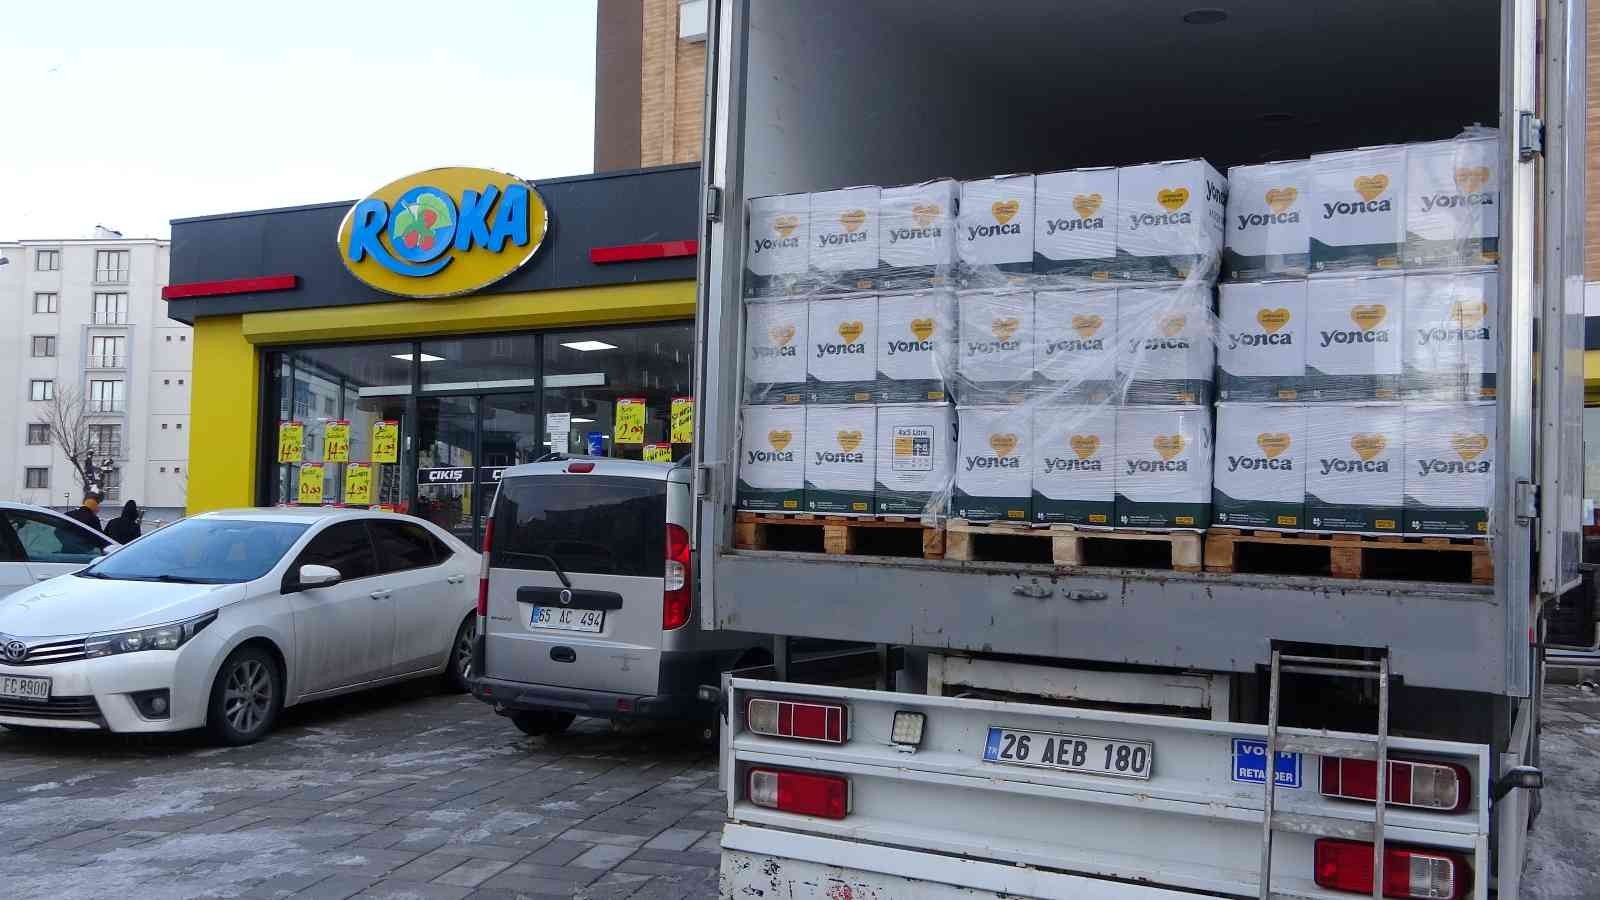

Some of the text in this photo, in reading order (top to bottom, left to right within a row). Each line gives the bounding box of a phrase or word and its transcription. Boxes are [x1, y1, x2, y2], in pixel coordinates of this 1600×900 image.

[1323, 199, 1391, 219] yonca
[1421, 193, 1494, 213] yonca
[1047, 216, 1104, 235] yonca
[1129, 211, 1191, 231] yonca
[1237, 211, 1300, 230] yonca
[350, 184, 529, 277] ROKA
[819, 230, 868, 247] yonca
[889, 226, 942, 243] yonca
[967, 221, 1021, 241] yonca
[754, 236, 799, 255] yonca
[1229, 331, 1292, 350] yonca
[1320, 328, 1389, 347] yonca
[1417, 326, 1490, 346] yonca
[752, 344, 797, 361] yonca
[816, 341, 865, 358] yonca
[967, 339, 1020, 357] yonca
[1046, 337, 1104, 354] yonca
[748, 449, 793, 465] yonca
[815, 451, 864, 466] yonca
[966, 454, 1020, 472] yonca
[1044, 456, 1101, 474] yonca
[1228, 456, 1292, 472] yonca
[1320, 457, 1388, 475] yonca
[429, 470, 463, 482] ÇIKIŞ
[1127, 458, 1188, 476] yonca
[1418, 458, 1490, 476] yonca
[560, 609, 572, 624] AC
[580, 611, 601, 626] 494
[4, 677, 48, 697] FC 8900
[1000, 733, 1031, 761] 26
[1041, 737, 1088, 767] AEB
[1104, 743, 1147, 774] 180
[1239, 767, 1293, 783] RETADER
